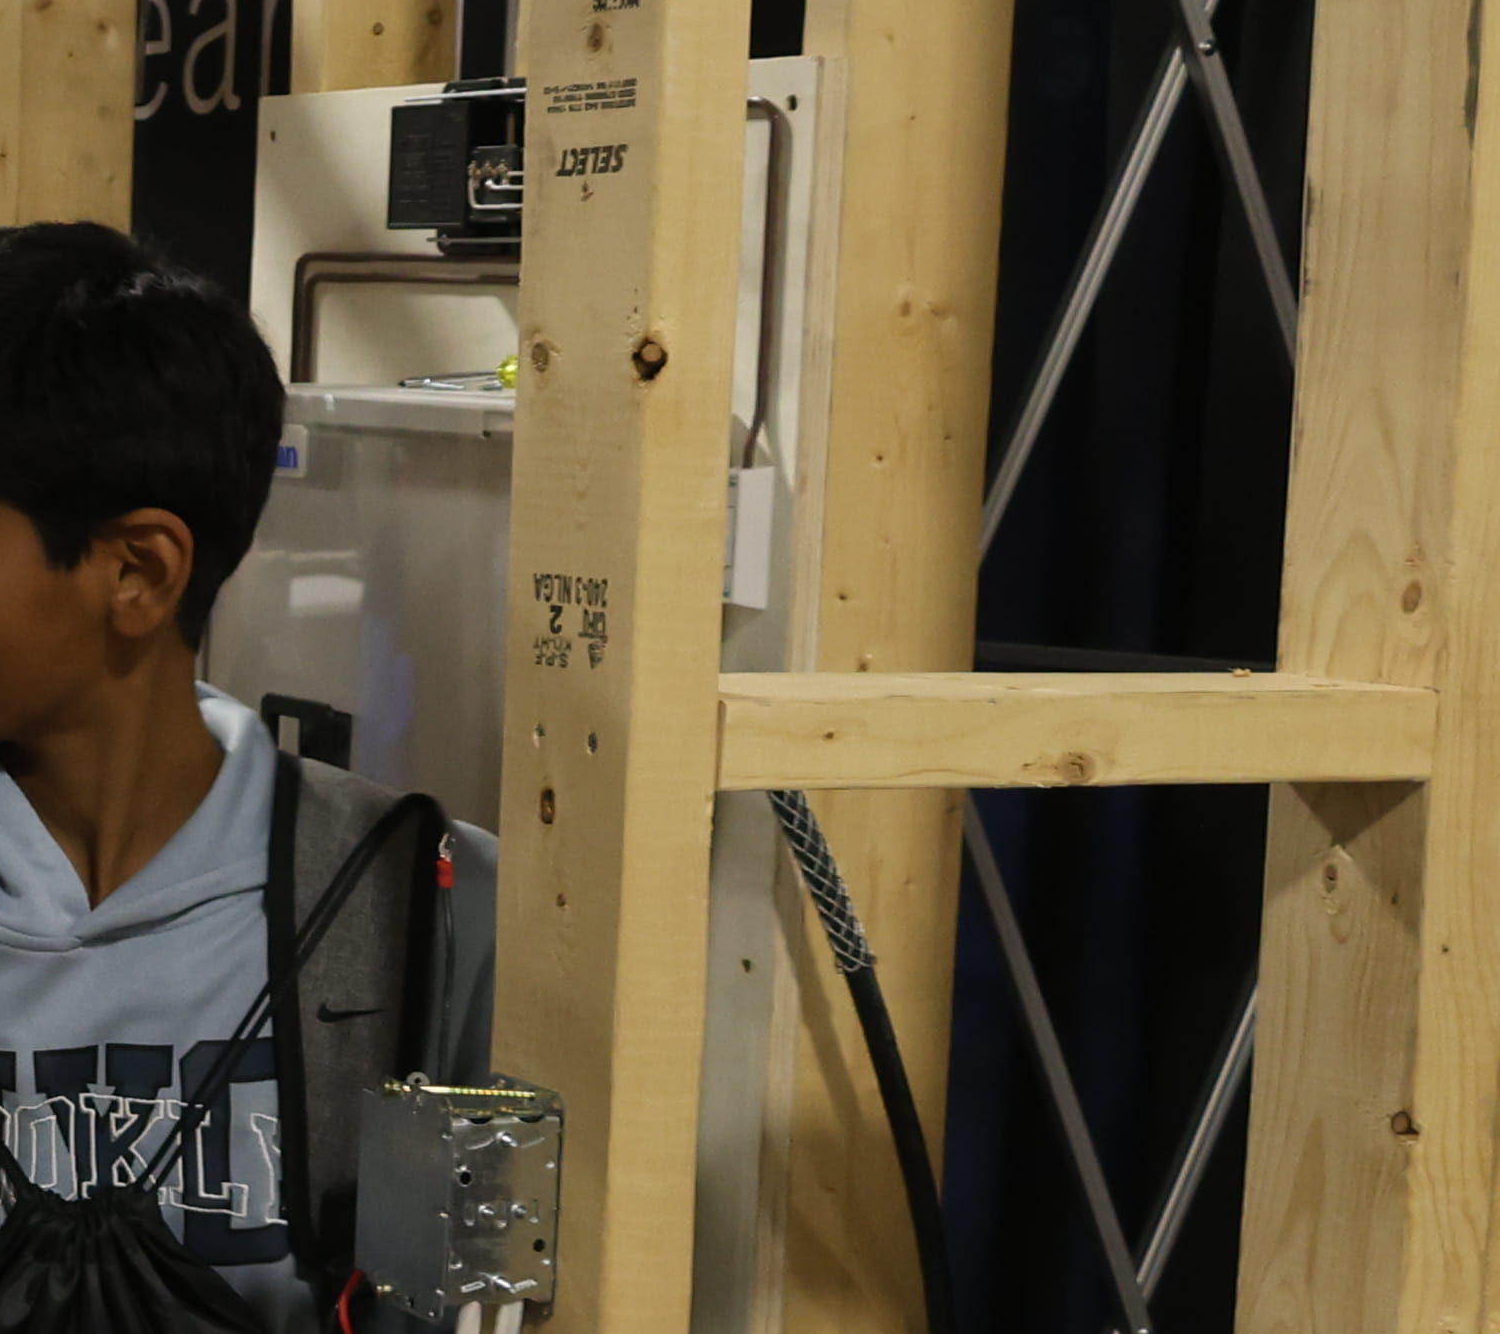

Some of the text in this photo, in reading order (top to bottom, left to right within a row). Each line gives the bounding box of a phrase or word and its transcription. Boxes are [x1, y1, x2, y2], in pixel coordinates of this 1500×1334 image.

[556, 144, 628, 177] SELECT
[533, 572, 572, 604] NLGA
[548, 605, 563, 635] 2
